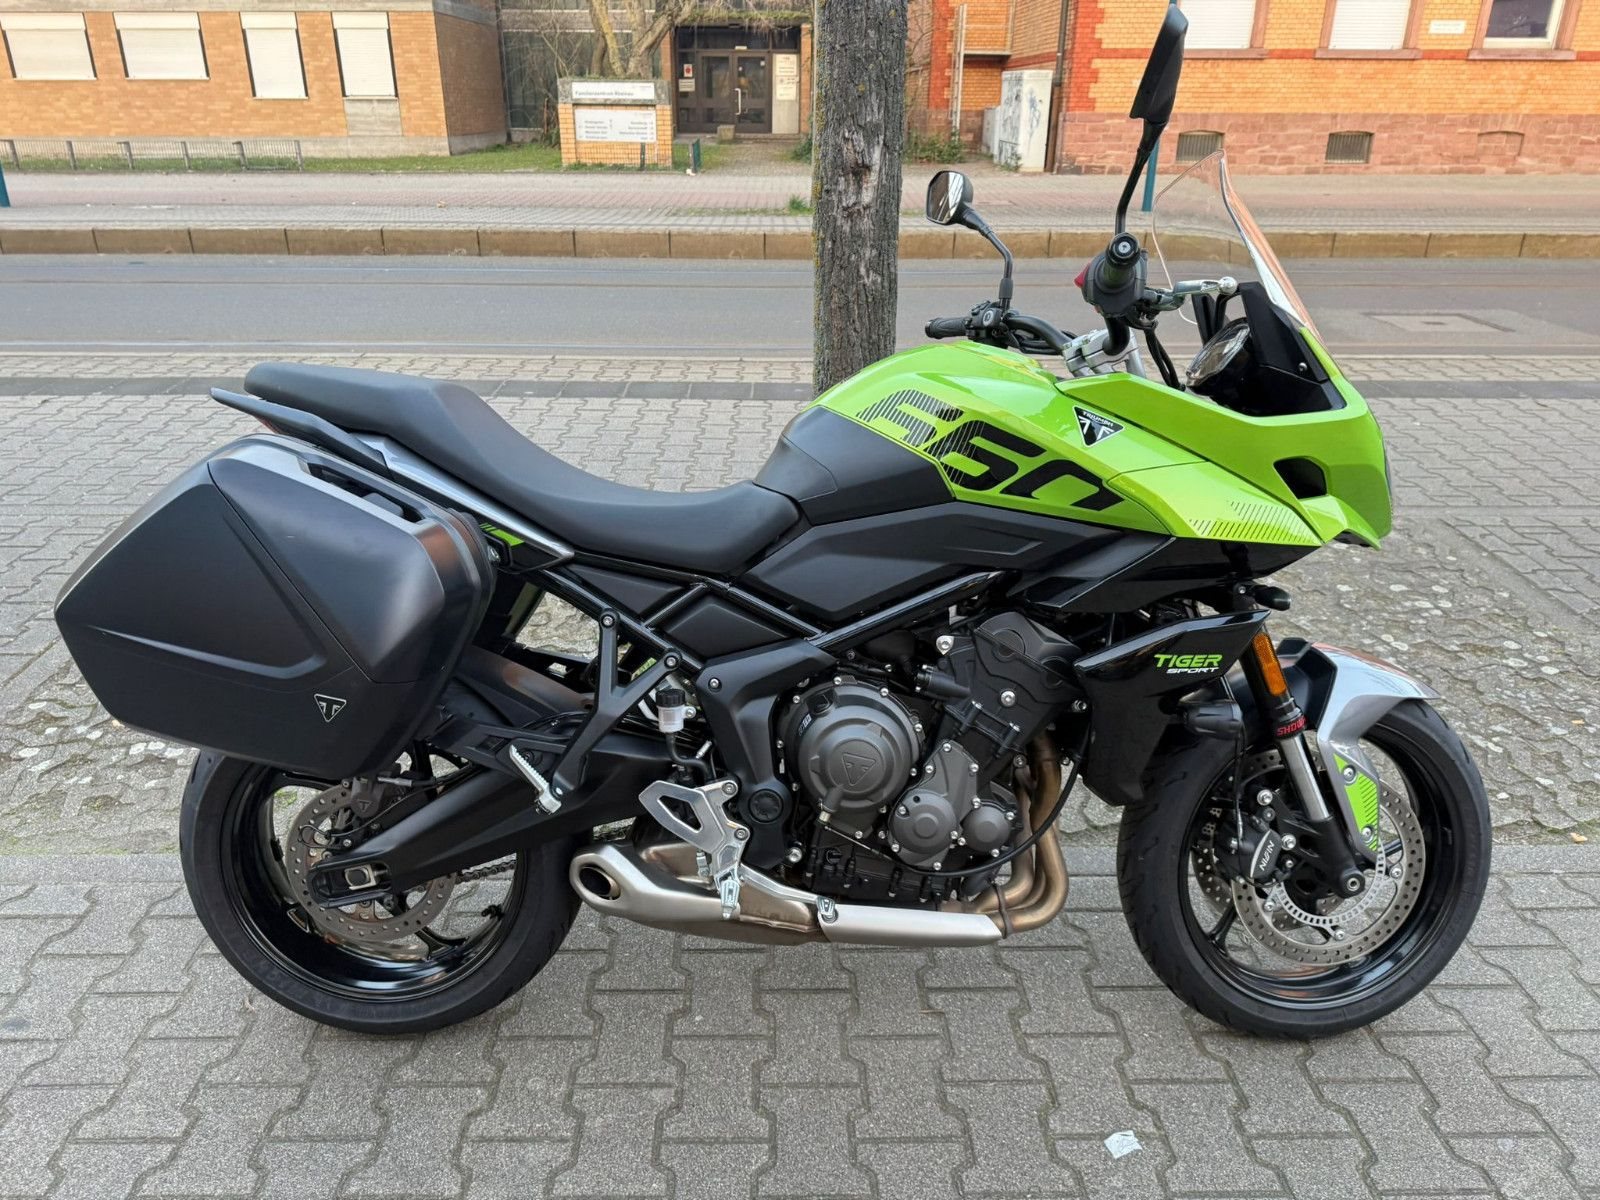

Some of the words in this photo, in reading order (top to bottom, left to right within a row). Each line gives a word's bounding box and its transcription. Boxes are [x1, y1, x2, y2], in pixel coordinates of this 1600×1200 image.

[1082, 410, 1114, 427] TRIUMPH
[1154, 653, 1223, 668] TIGER
[1166, 666, 1220, 674] SPORT
[1276, 716, 1306, 736] SHOW
